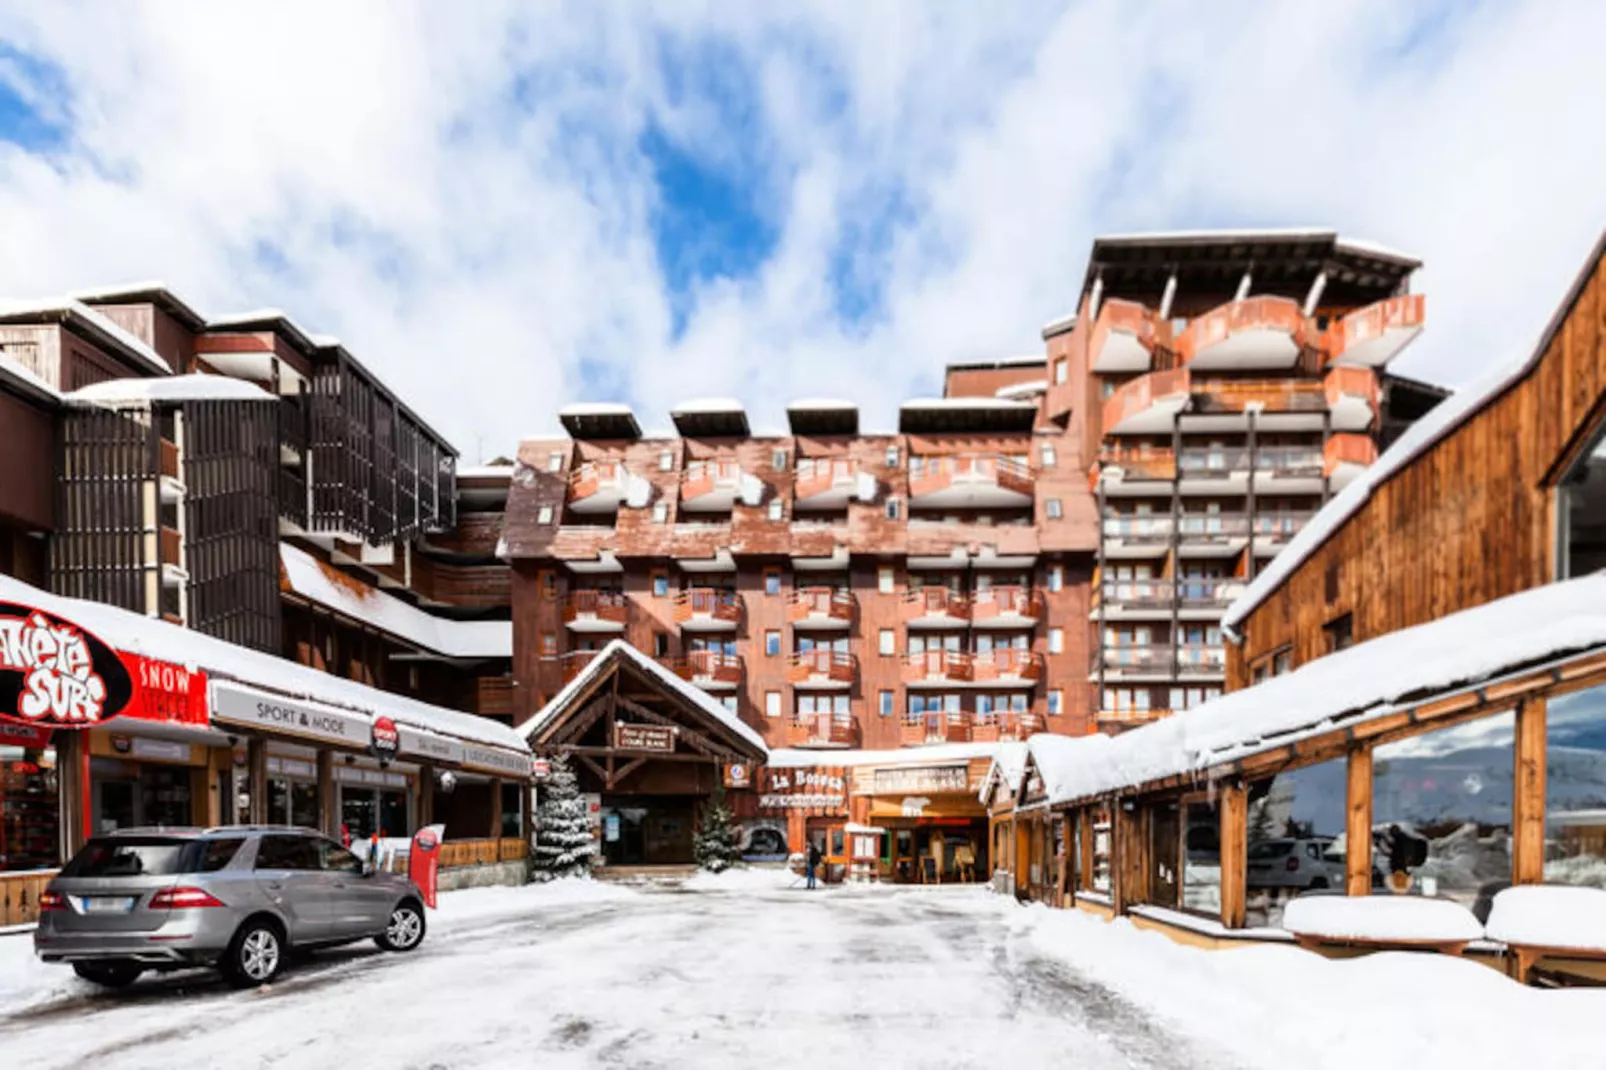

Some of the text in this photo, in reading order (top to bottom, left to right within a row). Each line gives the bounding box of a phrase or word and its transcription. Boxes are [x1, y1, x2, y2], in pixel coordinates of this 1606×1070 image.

[140, 661, 190, 694] SNOW
[22, 668, 105, 721] SURF
[256, 702, 346, 735] SPORT & MODE
